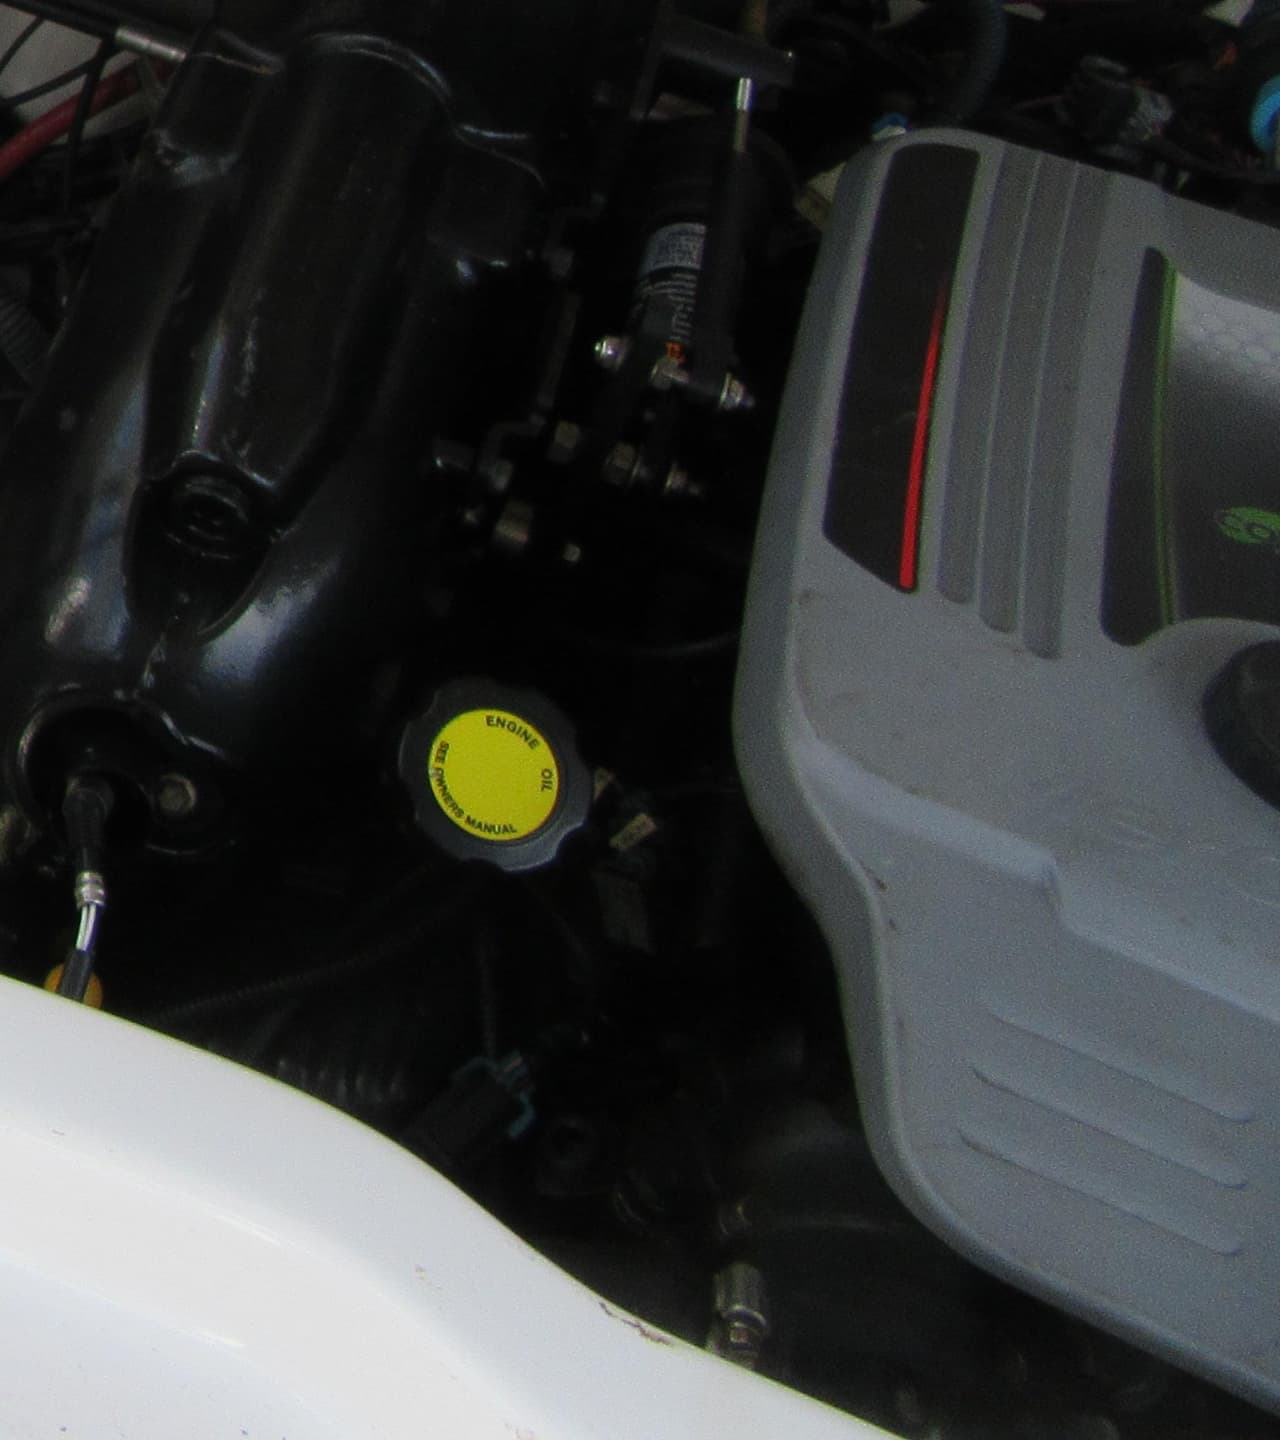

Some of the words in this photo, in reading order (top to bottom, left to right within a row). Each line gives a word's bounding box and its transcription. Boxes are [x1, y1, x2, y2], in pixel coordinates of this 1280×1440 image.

[435, 740, 450, 764] SEE
[485, 714, 541, 750] ENGINE
[541, 768, 553, 792] OIL
[433, 767, 465, 819] OWNERS
[464, 815, 517, 835] MANUAL
